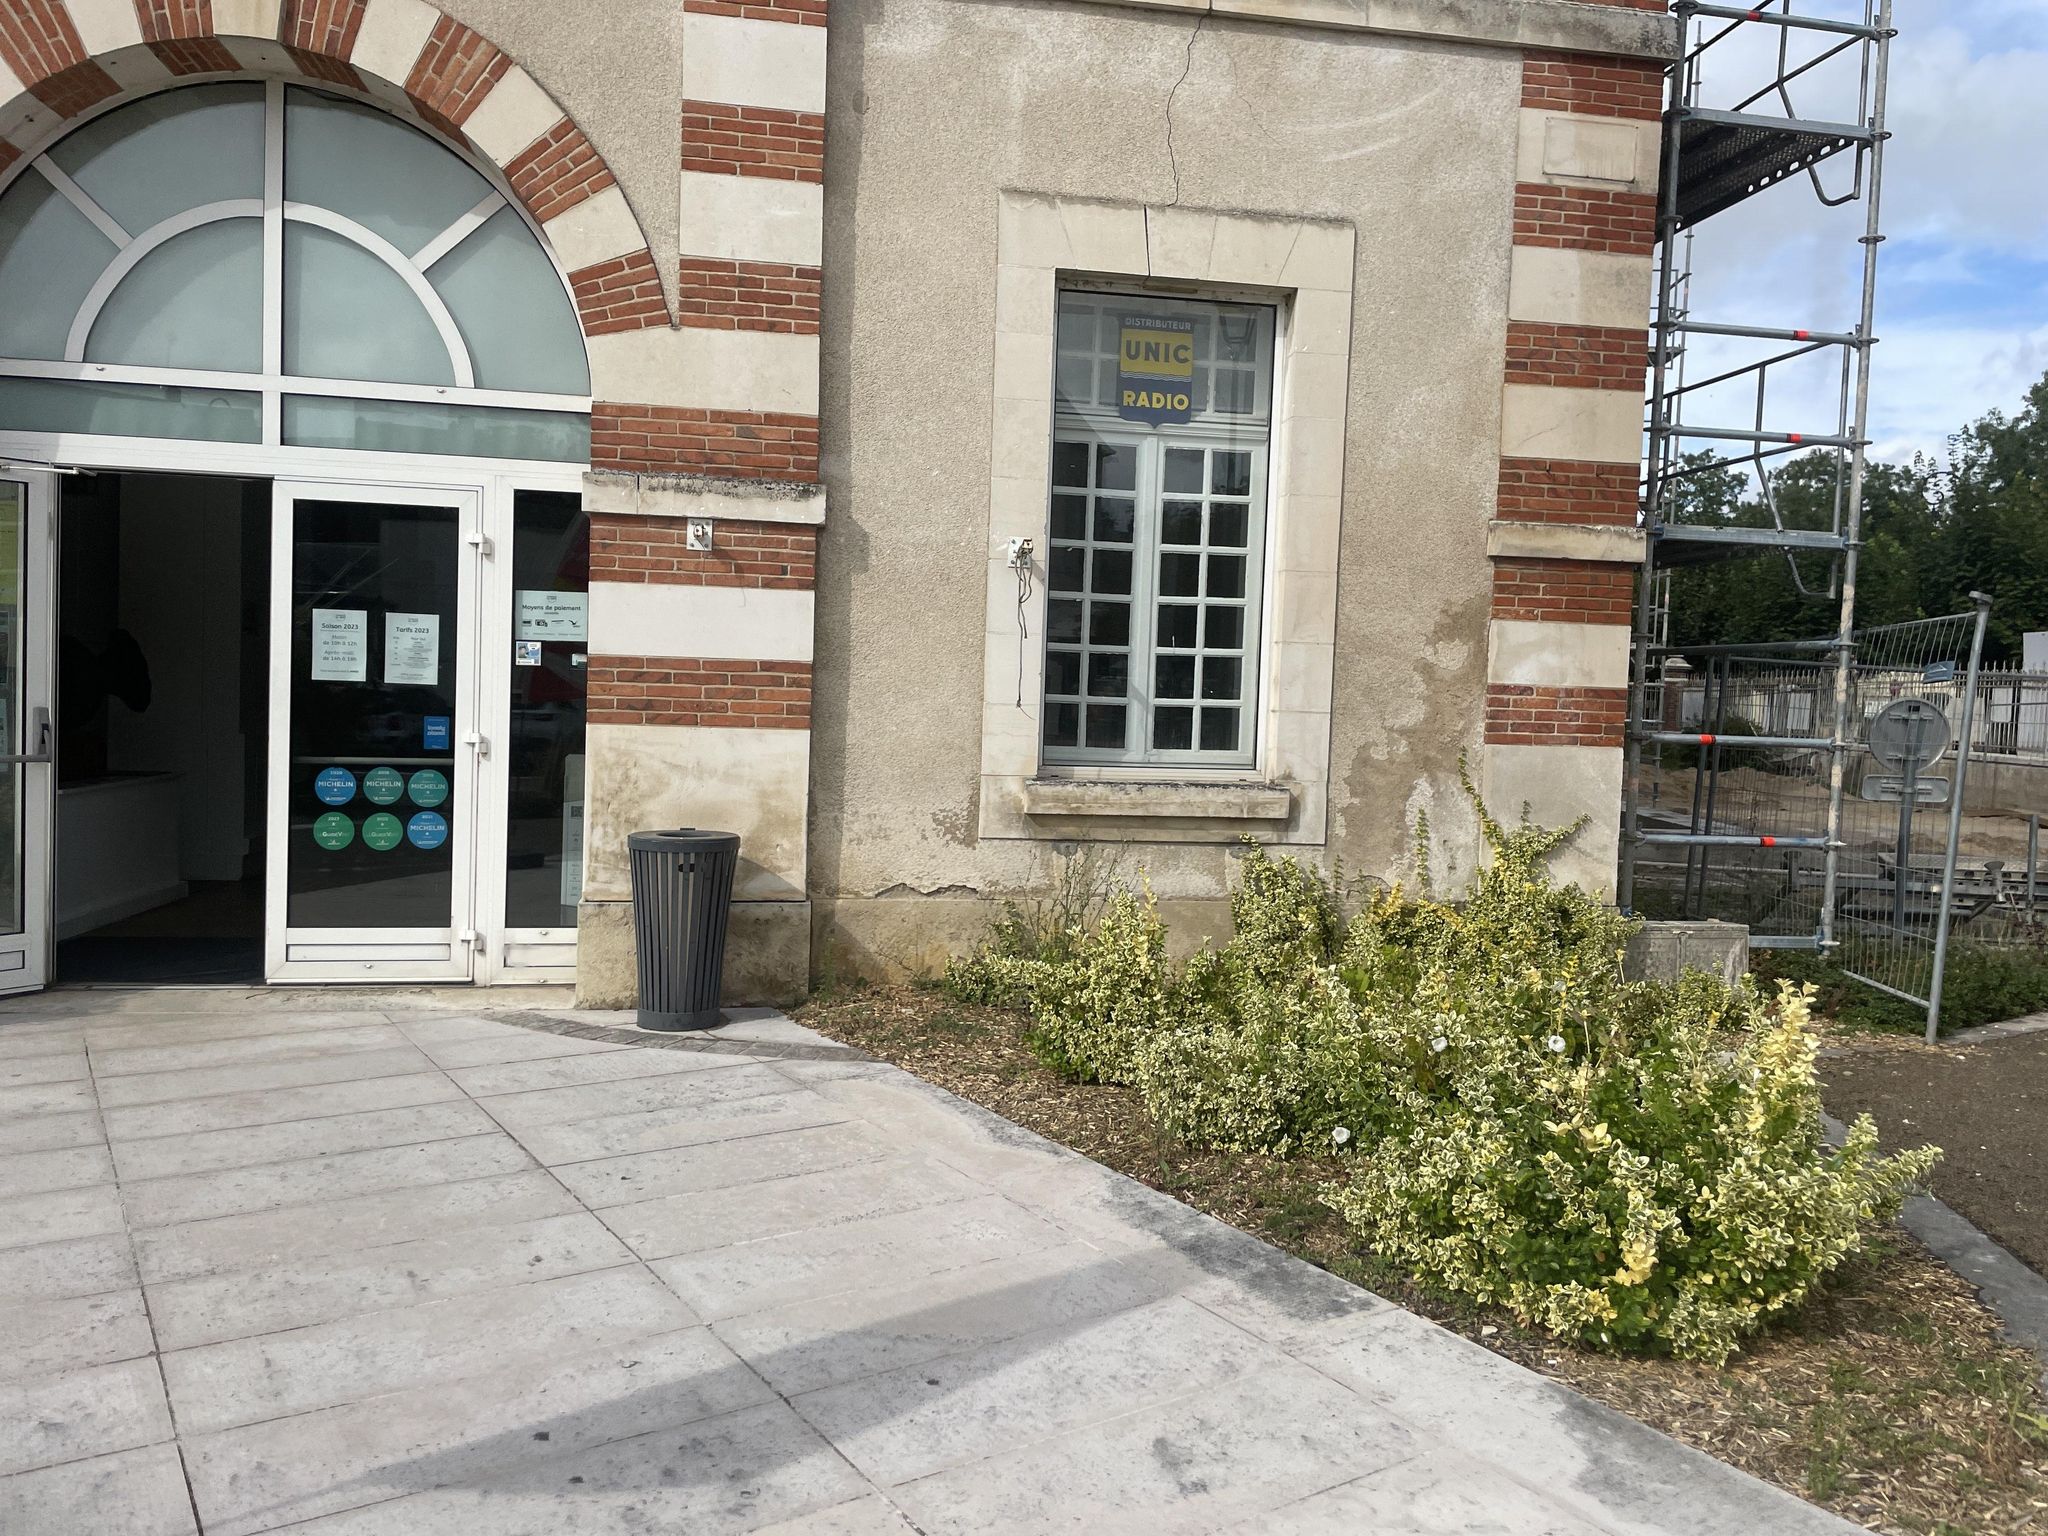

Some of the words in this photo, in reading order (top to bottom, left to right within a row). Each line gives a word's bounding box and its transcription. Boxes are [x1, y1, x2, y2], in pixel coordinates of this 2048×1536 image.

[1125, 317, 1191, 330] DISTRIBUTEUR
[1126, 340, 1190, 364] UNIC
[1123, 390, 1189, 410] RADIO
